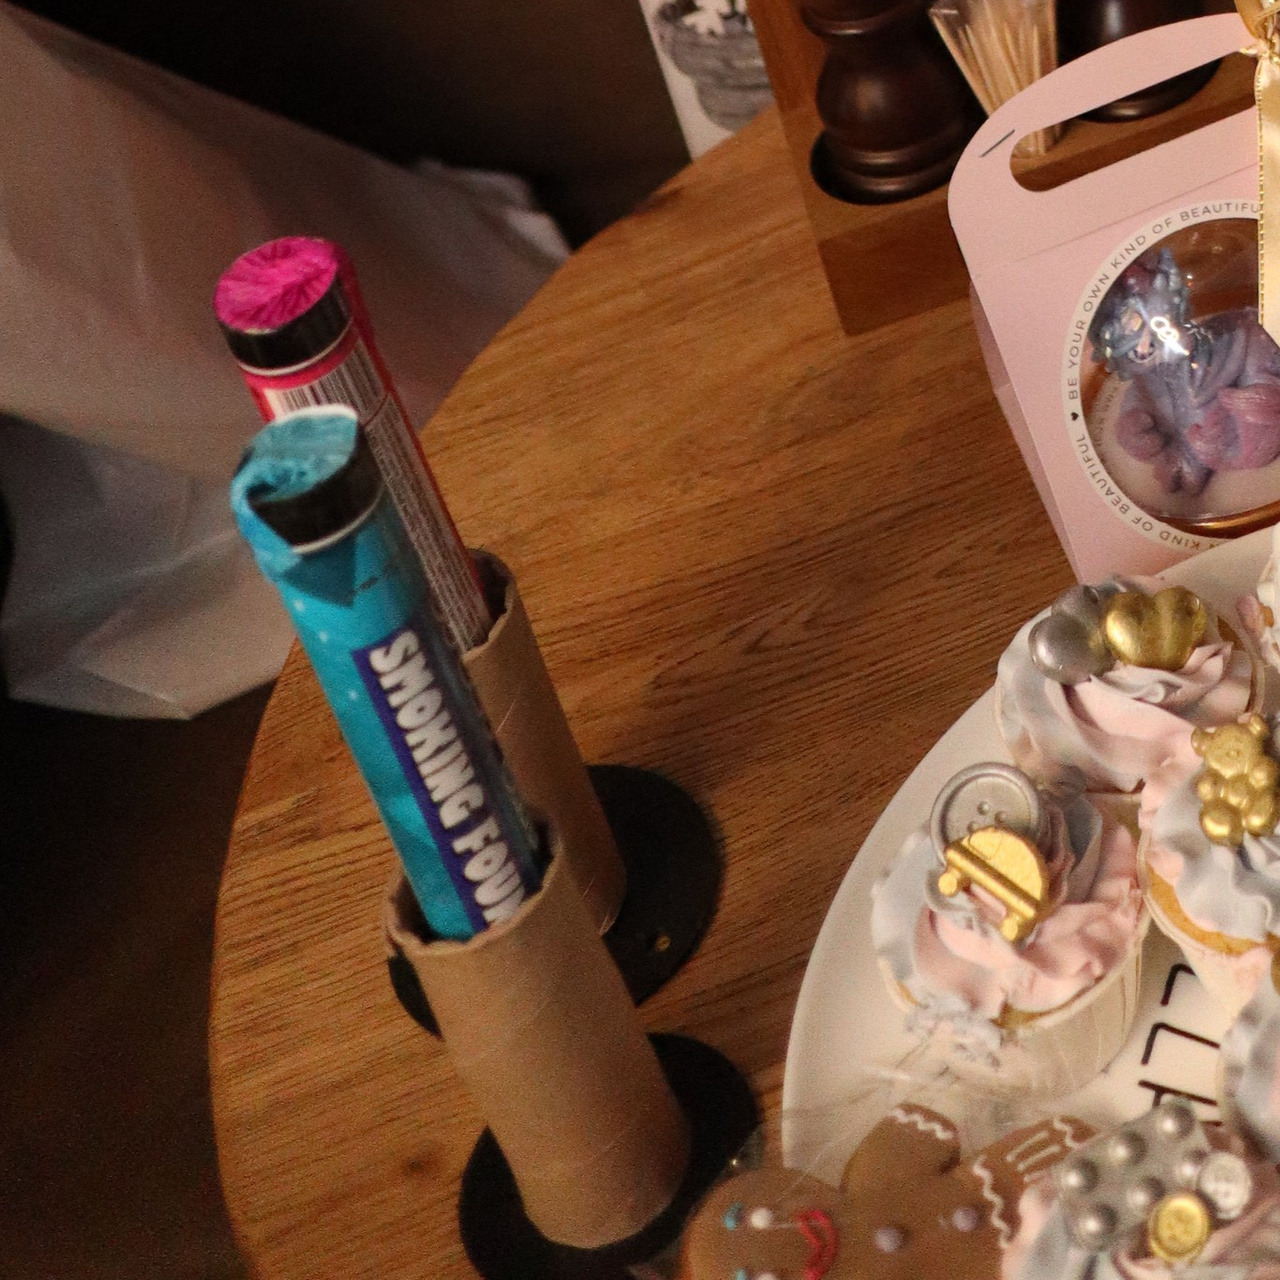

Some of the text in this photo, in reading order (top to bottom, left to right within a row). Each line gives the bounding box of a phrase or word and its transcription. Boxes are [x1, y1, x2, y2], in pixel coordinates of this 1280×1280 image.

[1068, 201, 1260, 400] BE YOUR OWN KIND OF BEAUTIFU
[1075, 434, 1131, 515] BEAUTIFUL
[1131, 516, 1154, 532] OF
[1159, 530, 1201, 550] KIND
[369, 629, 485, 830] SMOKING
